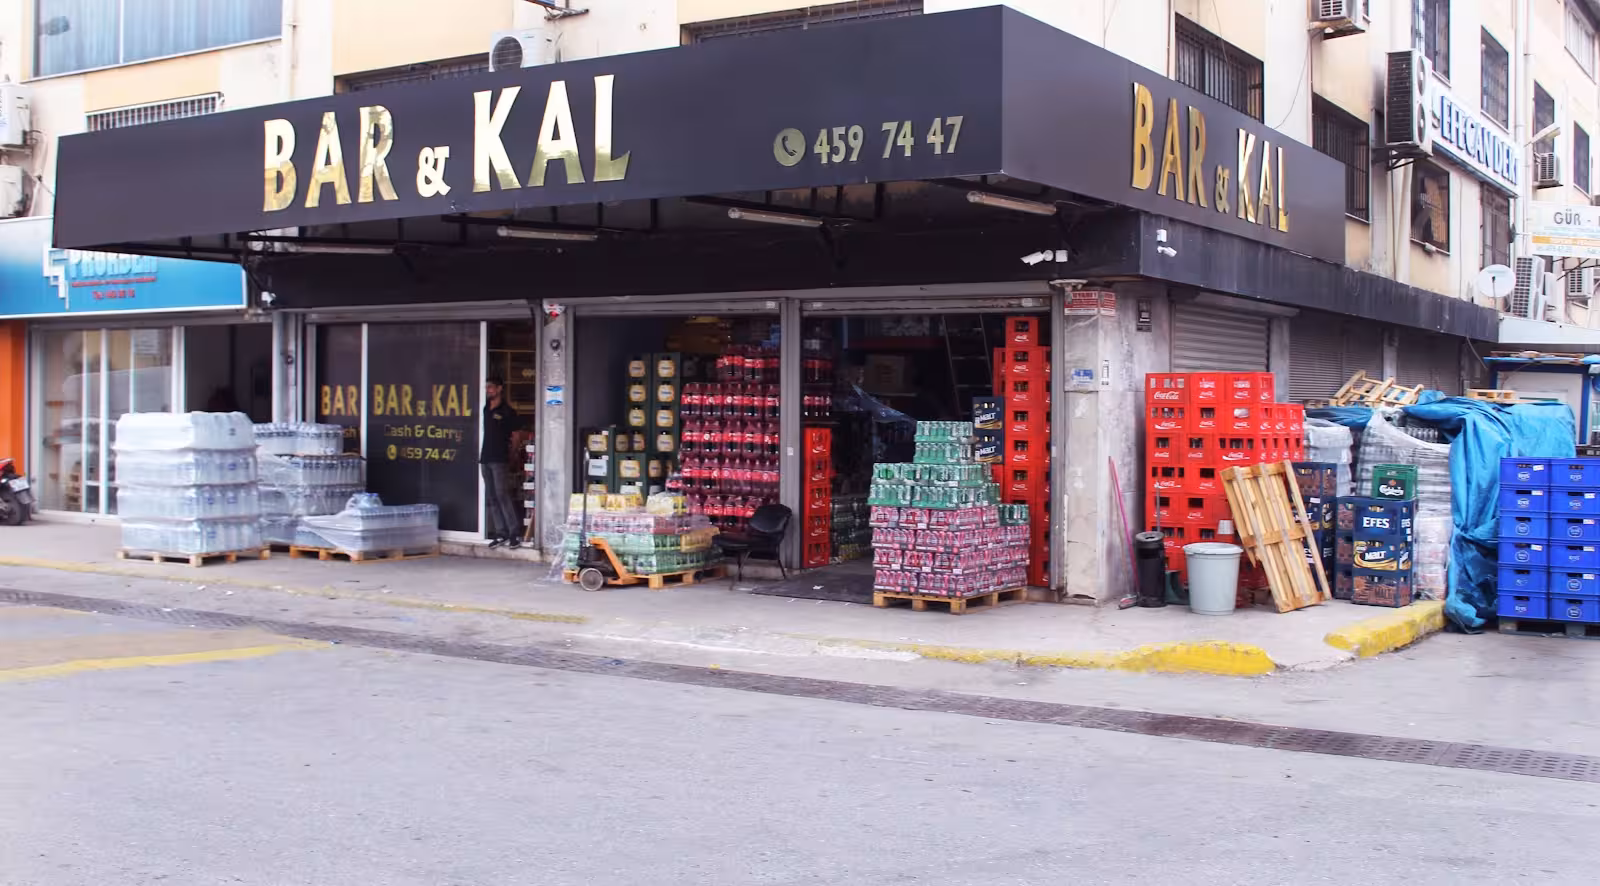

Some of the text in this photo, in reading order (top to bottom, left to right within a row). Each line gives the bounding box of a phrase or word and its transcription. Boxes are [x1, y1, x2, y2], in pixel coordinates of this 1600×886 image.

[263, 74, 630, 212] BAR & KAL
[814, 115, 963, 164] 459 74 47
[1131, 81, 1289, 233] BAR & KAL
[321, 385, 359, 416] BAR
[374, 384, 472, 417] BAR & KAL
[414, 425, 424, 436] &
[427, 425, 464, 441] Carry
[424, 448, 439, 460] 74
[1363, 516, 1390, 529] EFES
